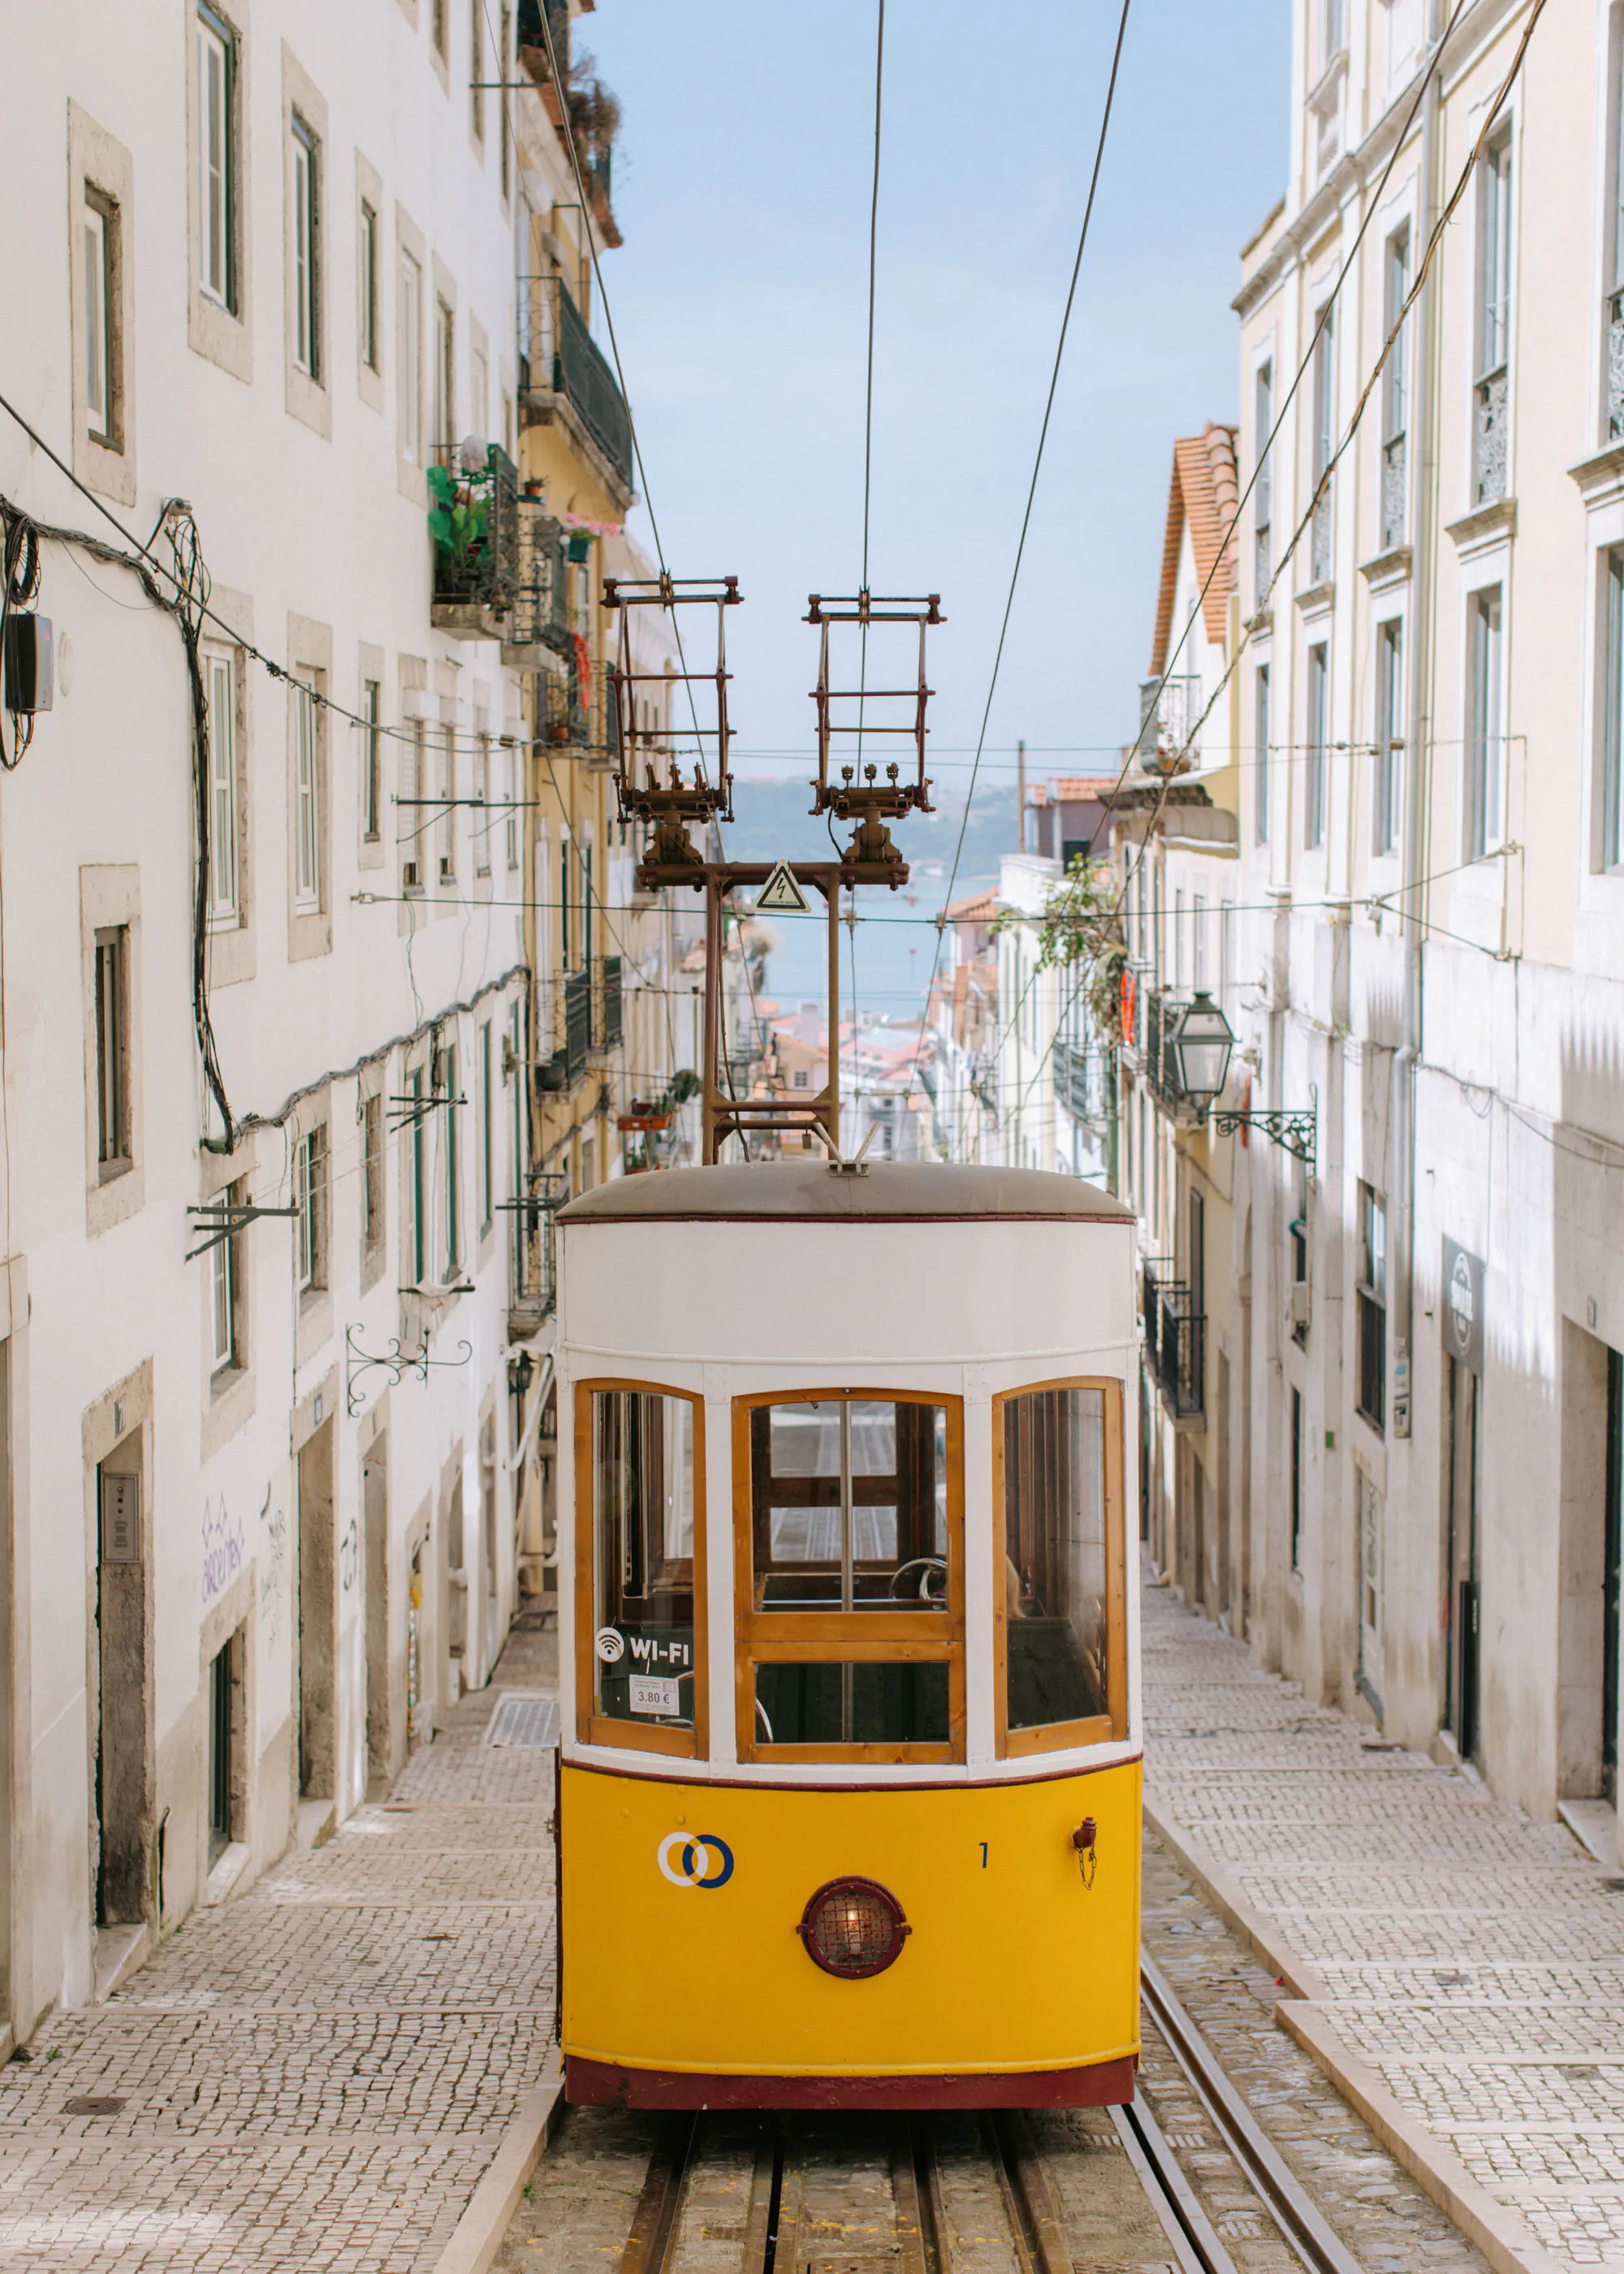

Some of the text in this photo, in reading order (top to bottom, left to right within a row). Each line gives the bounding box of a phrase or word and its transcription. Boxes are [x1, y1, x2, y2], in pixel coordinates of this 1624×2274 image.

[630, 1636, 689, 1666] WI-FI
[638, 1691, 670, 1705] 3.80 €
[978, 1842, 988, 1869] 1
